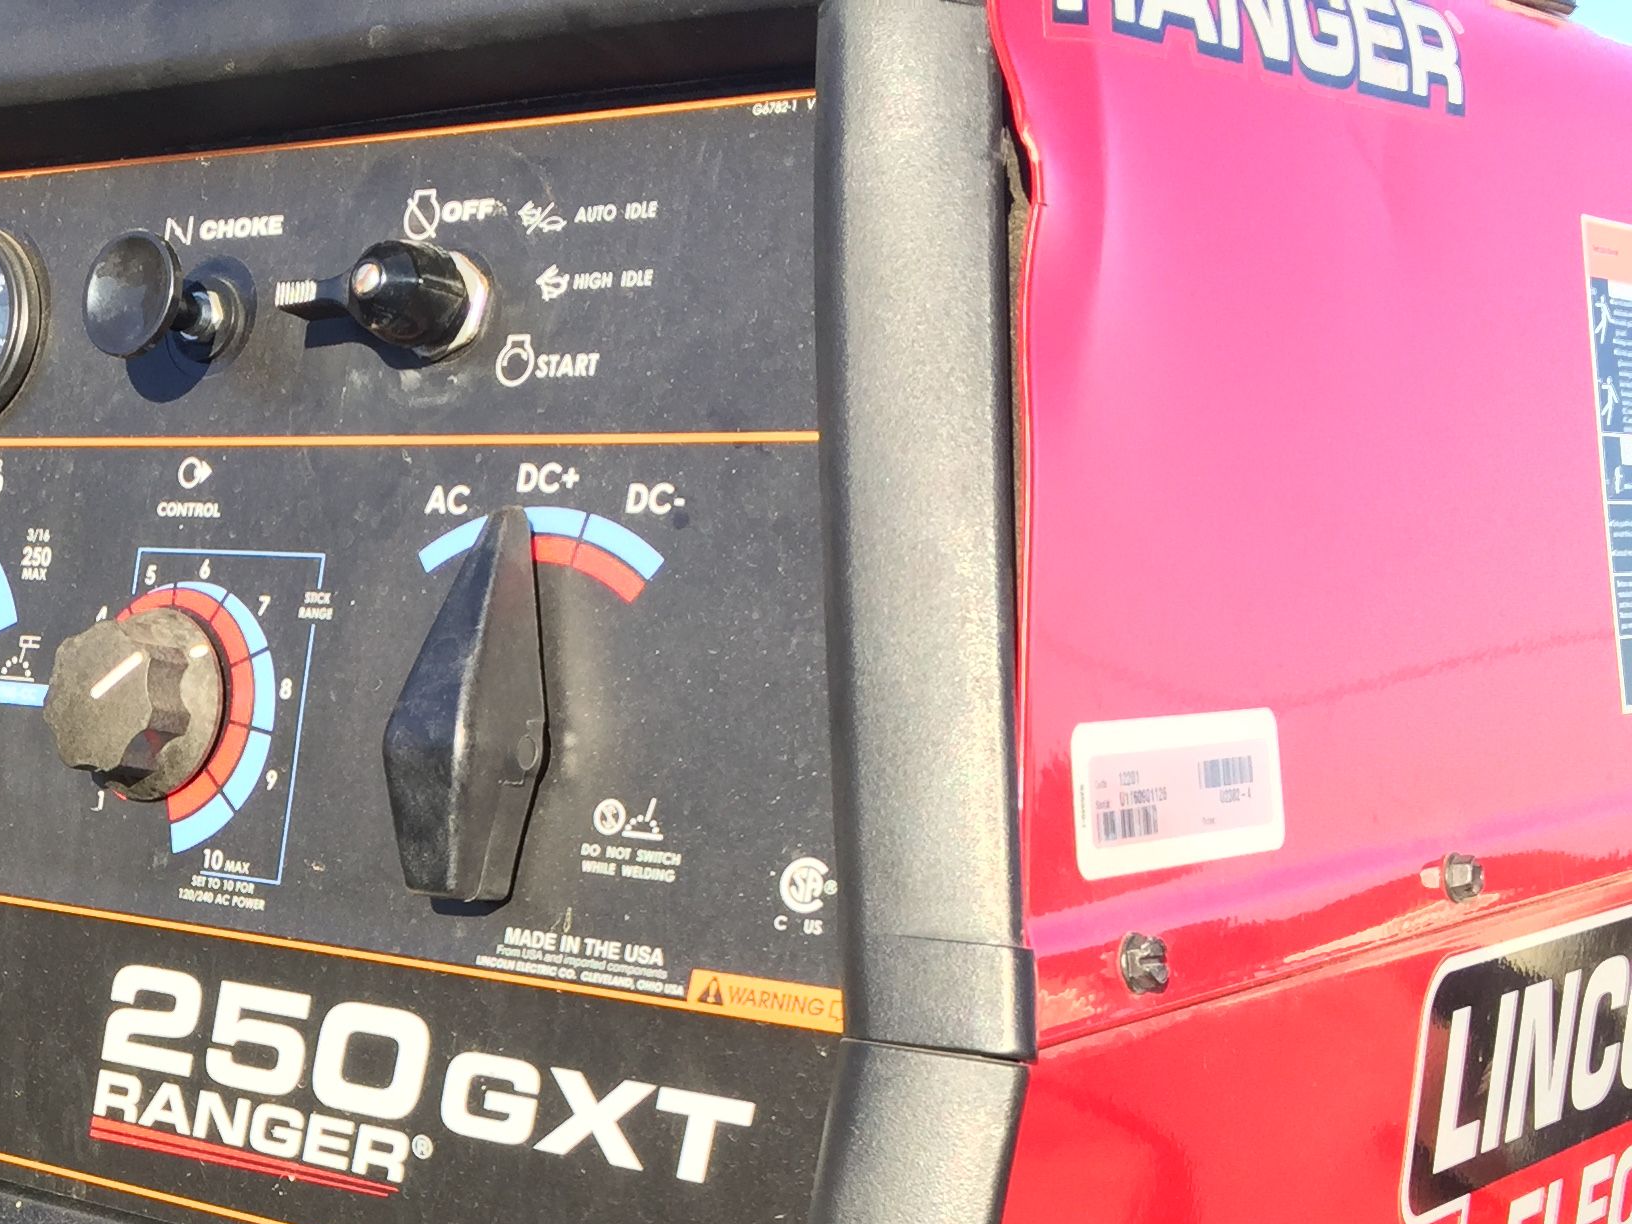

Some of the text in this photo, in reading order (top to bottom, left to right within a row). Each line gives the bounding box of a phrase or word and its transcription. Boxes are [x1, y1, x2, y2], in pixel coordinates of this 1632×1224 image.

[1053, 0, 1466, 116] NGER
[441, 197, 496, 223] OFF
[574, 201, 658, 223] AUTO IDLE
[200, 215, 284, 240] CHOKE
[573, 268, 653, 290] HIGH IDLE
[535, 353, 600, 377] START
[516, 462, 580, 493] DC+
[157, 502, 221, 518] CONTROL
[424, 484, 471, 514] AC
[624, 482, 686, 515] DC-
[27, 528, 50, 542] 3/16
[20, 546, 52, 567] 250
[22, 567, 47, 581] MAX
[144, 564, 157, 586] 5
[199, 559, 211, 580] 6
[258, 595, 271, 616] 7
[304, 591, 331, 605] STICK
[298, 606, 333, 621] RANGE
[279, 678, 292, 701] 8
[266, 769, 278, 791] 9
[203, 848, 250, 874] 10 MAX
[580, 842, 682, 867] DO NOT SWITCH
[581, 859, 677, 883] WHILE WELDING
[191, 874, 255, 895] SET TO 10 FOR
[178, 887, 266, 911] 120/240 AC POWER
[773, 914, 824, 935] C US
[504, 926, 665, 967] MADE IN THE USA
[496, 944, 668, 980] From USA and imported components
[475, 954, 516, 972] LINCOLN
[516, 960, 558, 979] ELECTRIC
[557, 966, 578, 980] CO.
[636, 979, 663, 994] OHIO
[664, 983, 686, 998] USA
[728, 985, 825, 1017] WARNING
[101, 964, 756, 1185] 250 GXT
[1432, 954, 1632, 1175] LINC
